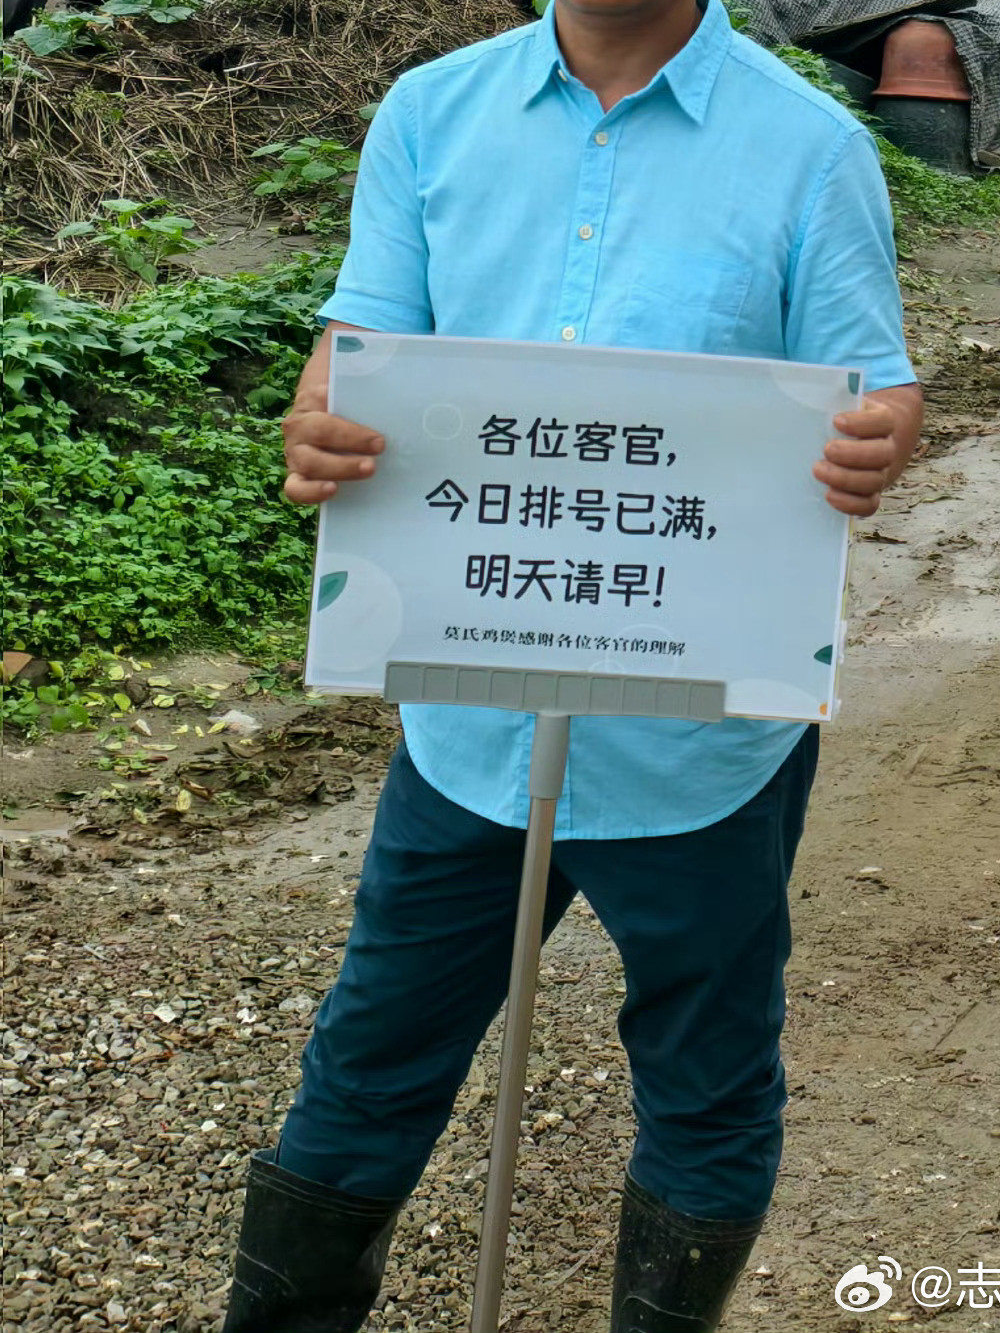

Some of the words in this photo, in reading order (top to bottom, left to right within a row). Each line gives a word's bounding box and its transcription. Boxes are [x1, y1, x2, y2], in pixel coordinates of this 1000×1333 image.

[478, 414, 677, 467] 各位客官，
[424, 479, 718, 541] 今日排号已满，
[465, 554, 666, 608] 明天请早！
[443, 626, 686, 656] 莫氏鸡煲感谢各位客官的理解
